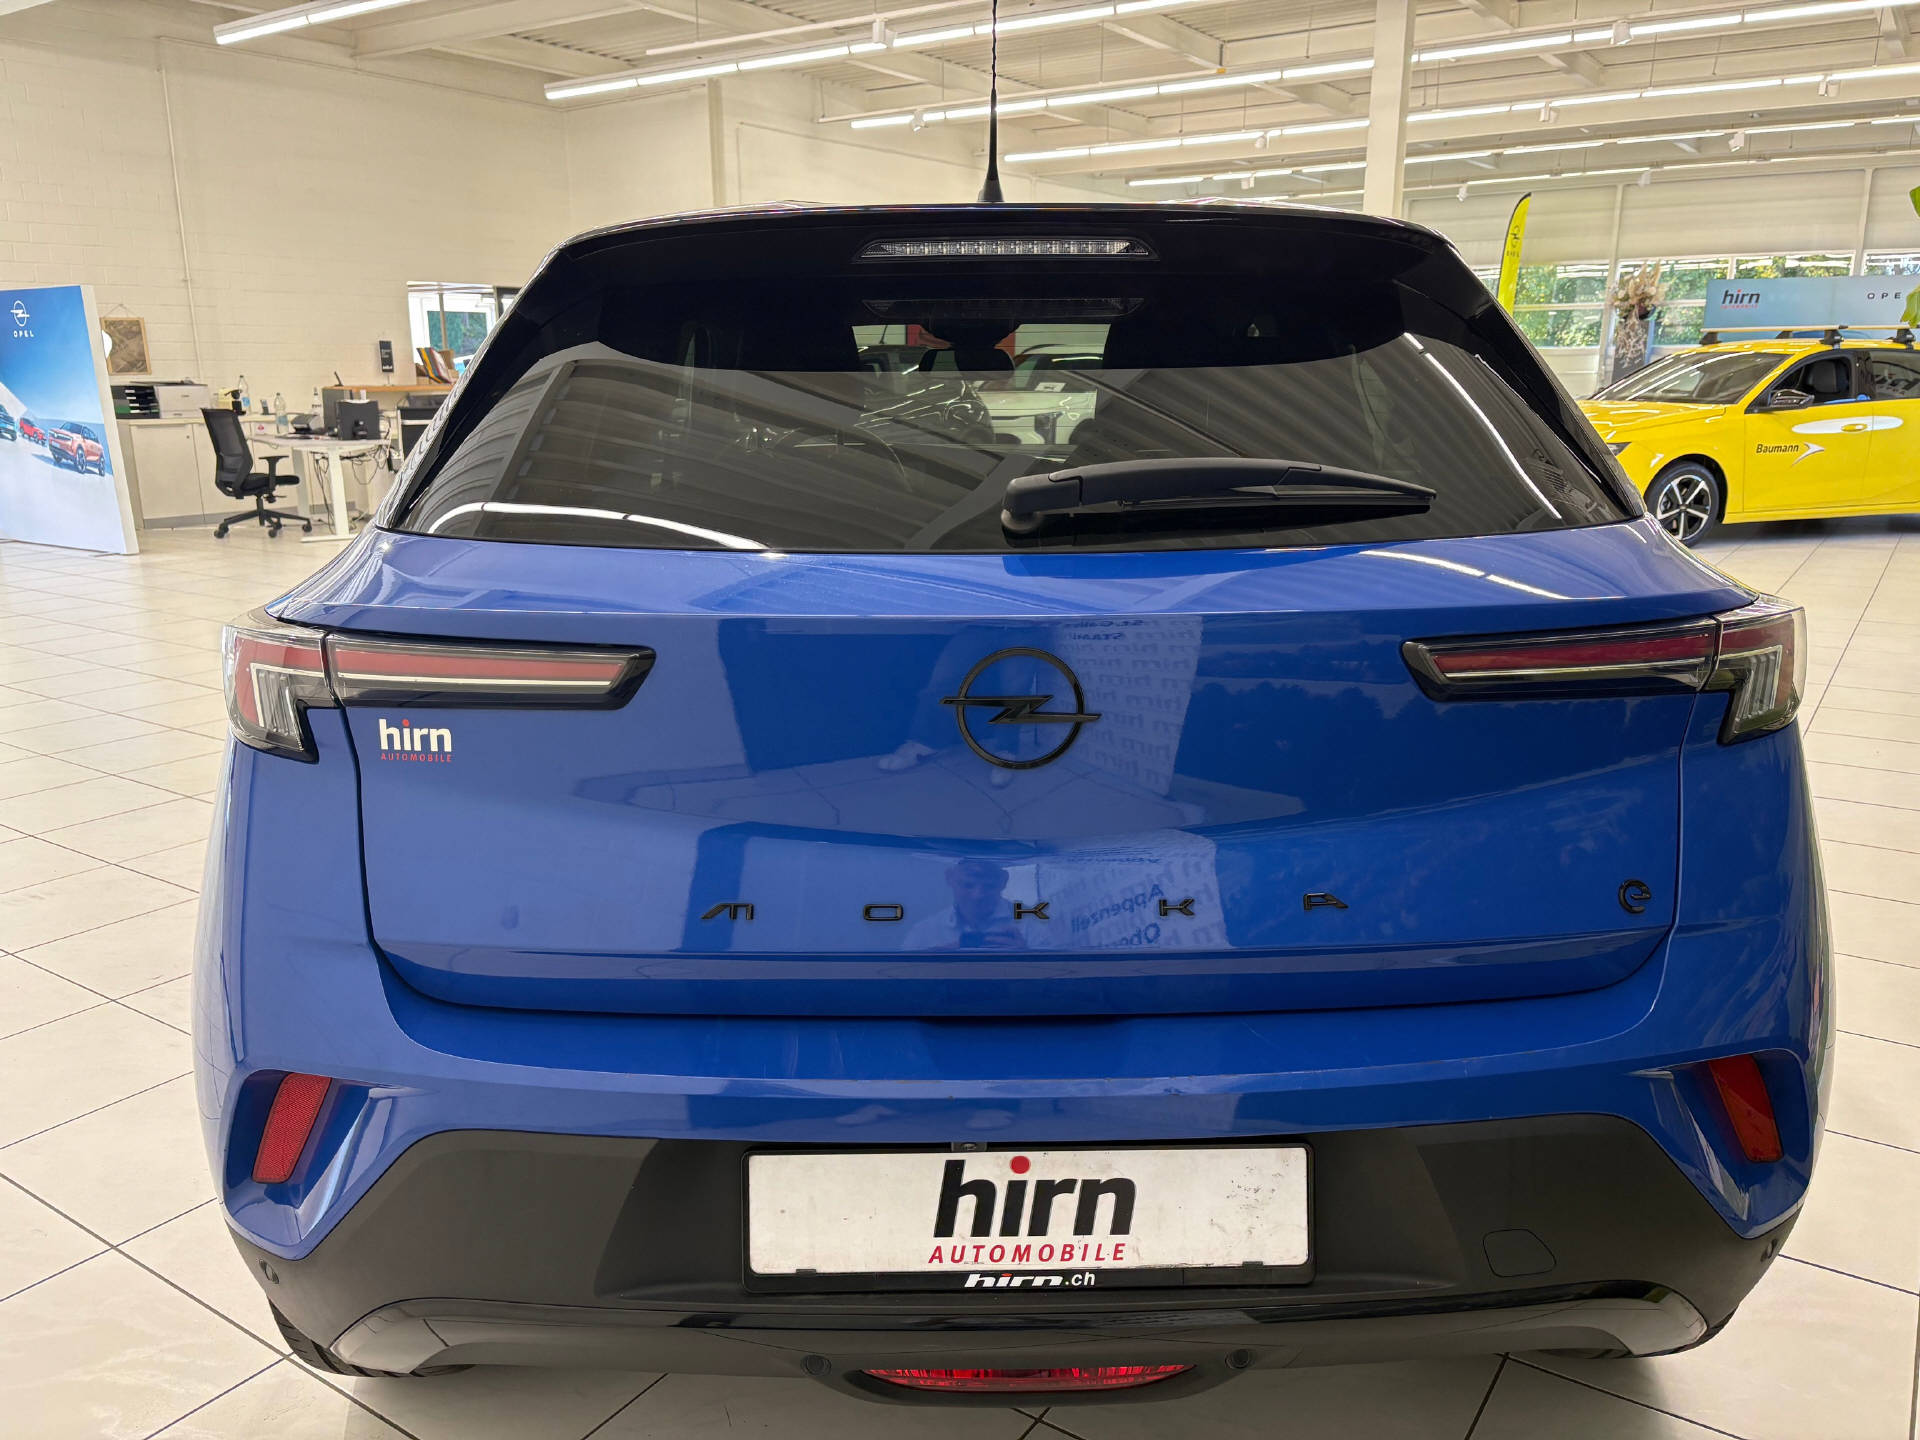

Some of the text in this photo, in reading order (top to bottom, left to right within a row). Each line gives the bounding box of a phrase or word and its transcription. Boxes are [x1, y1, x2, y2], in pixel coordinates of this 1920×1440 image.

[1721, 289, 1761, 304] hirn
[1867, 292, 1902, 300] OPE
[1756, 443, 1799, 454] Baumann
[379, 718, 452, 752] hirn
[381, 753, 452, 763] AUTOMOBILE
[933, 1155, 1137, 1238] hirn
[928, 1242, 1127, 1265] AUTOMOBILE
[964, 1271, 1096, 1289] hirn.ch
